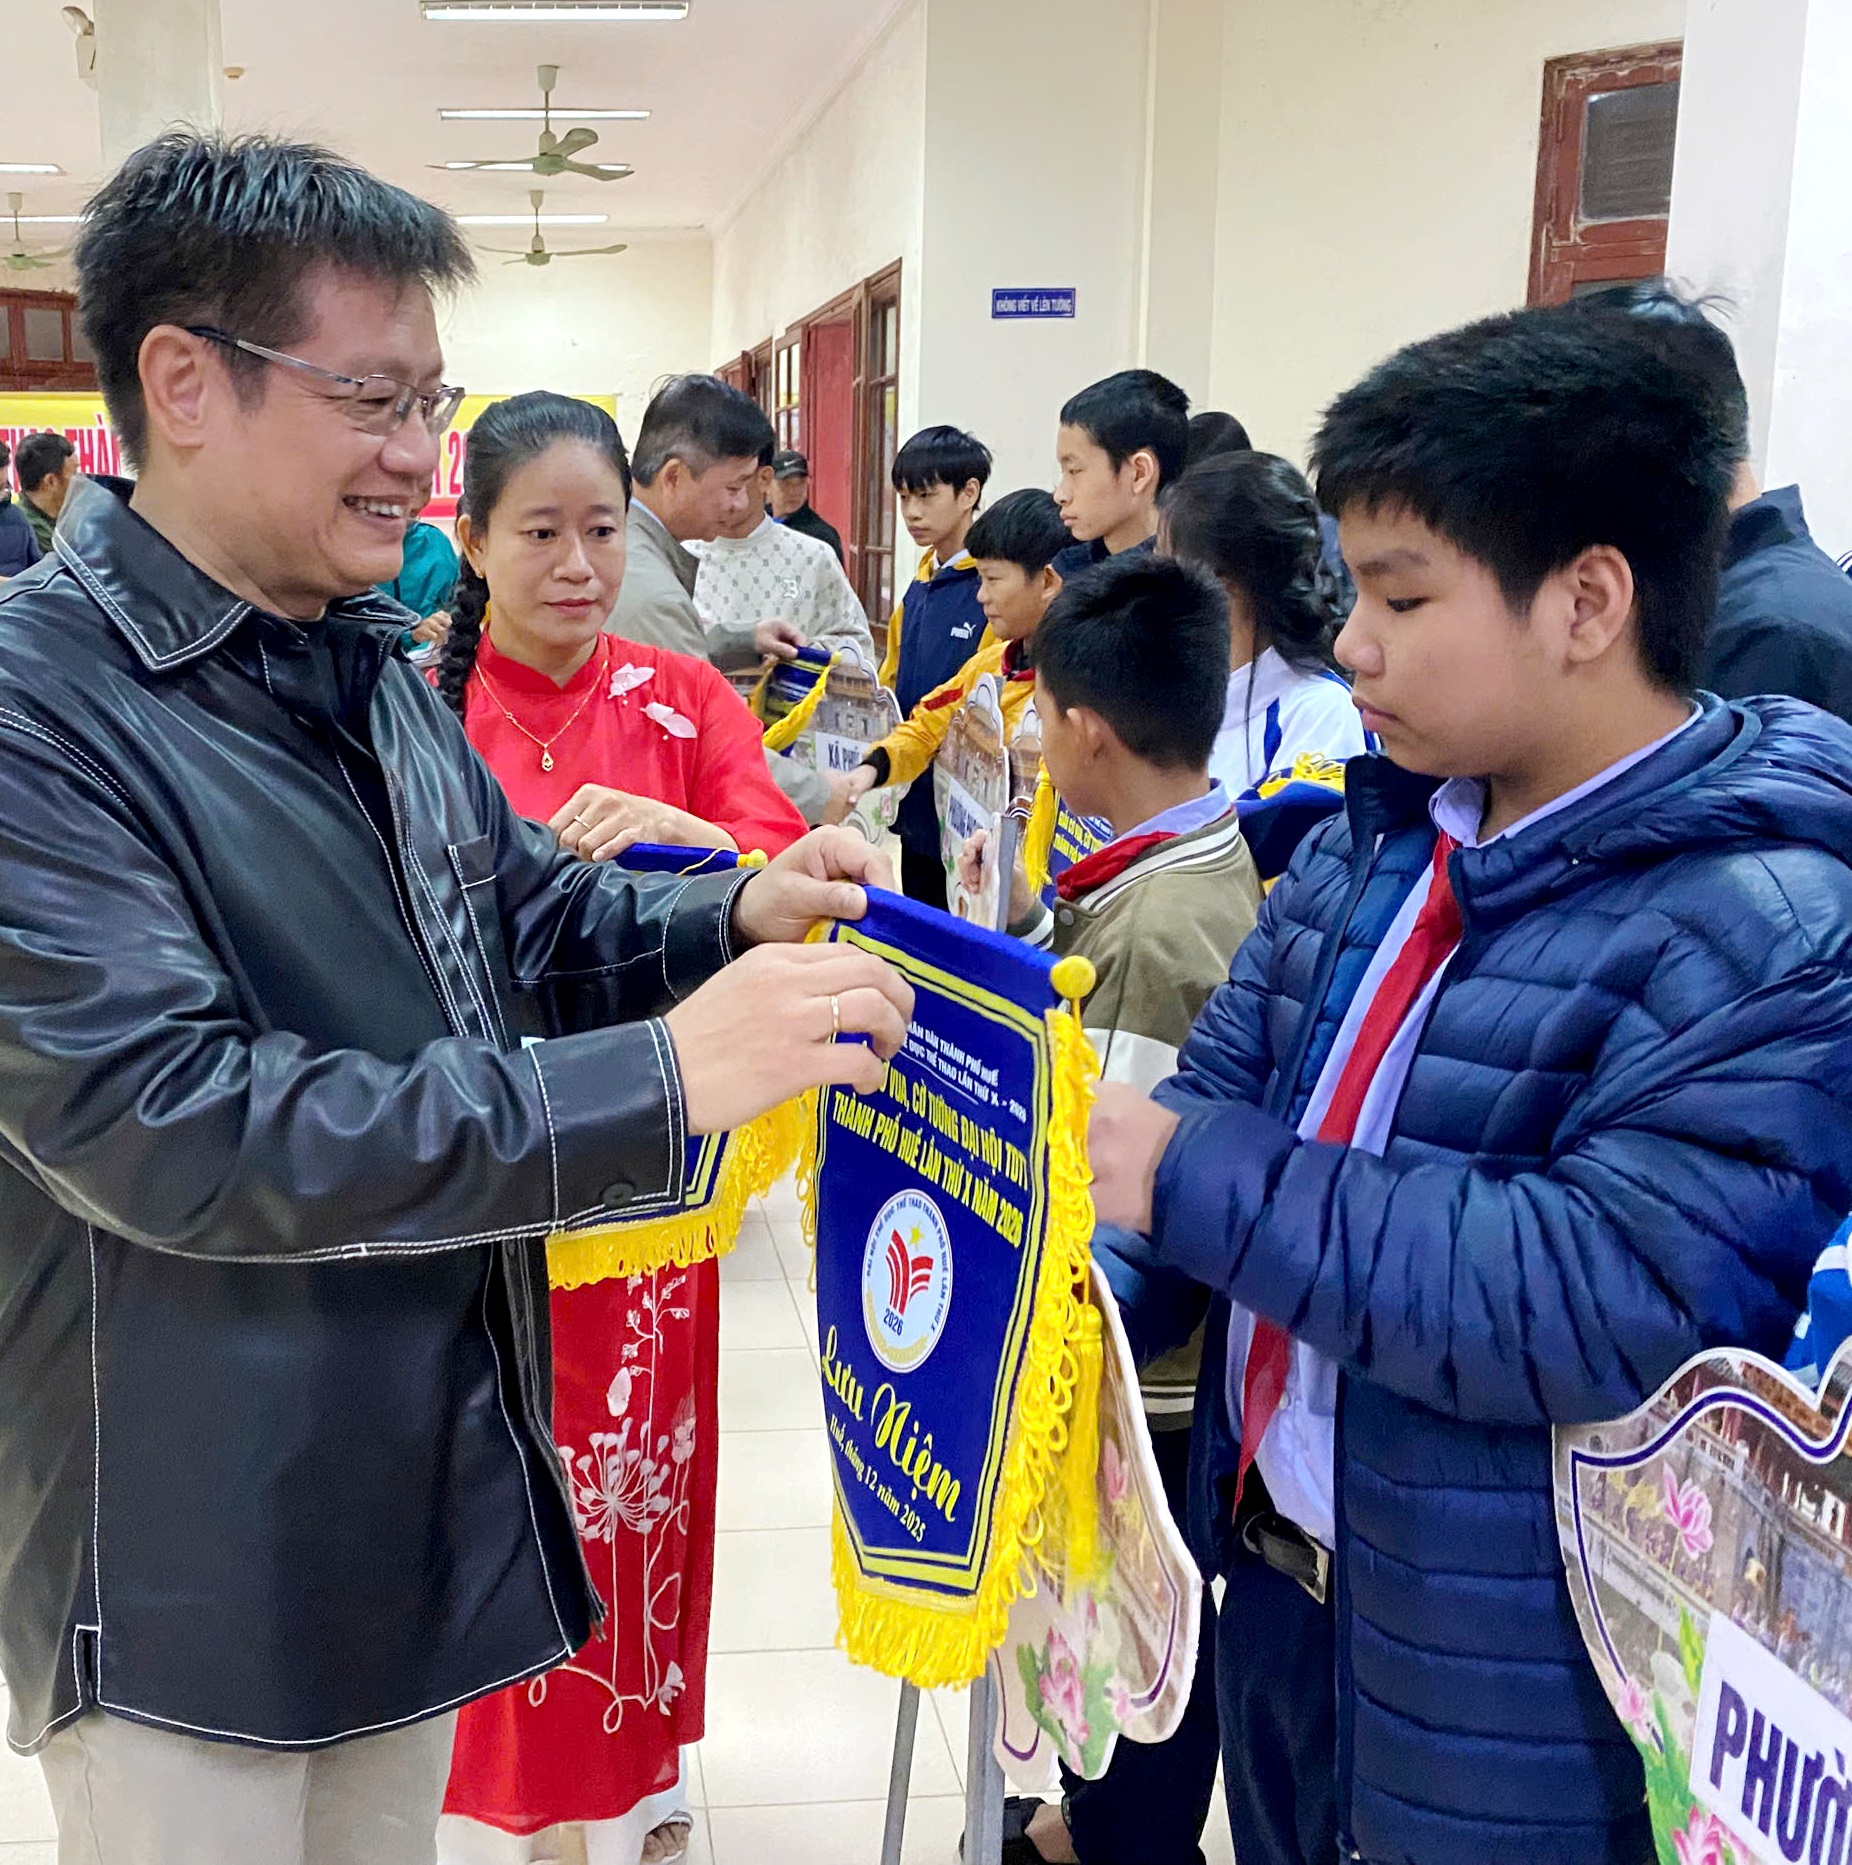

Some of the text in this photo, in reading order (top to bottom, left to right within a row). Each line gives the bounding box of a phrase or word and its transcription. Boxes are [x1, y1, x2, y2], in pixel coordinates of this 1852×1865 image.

[912, 1078, 927, 1119] CỜ
[833, 1090, 876, 1140] THÀNH
[872, 1112, 902, 1154] PHỐ
[897, 1126, 924, 1170] HUẾ
[961, 1170, 974, 1208] X
[883, 1308, 903, 1337] 2026
[822, 1325, 961, 1523] Lưu Niệm
[864, 1465, 878, 1492] 12
[877, 1484, 901, 1518] năm
[899, 1503, 927, 1543] 2025
[1709, 1679, 1852, 1865] PHƯỜ
